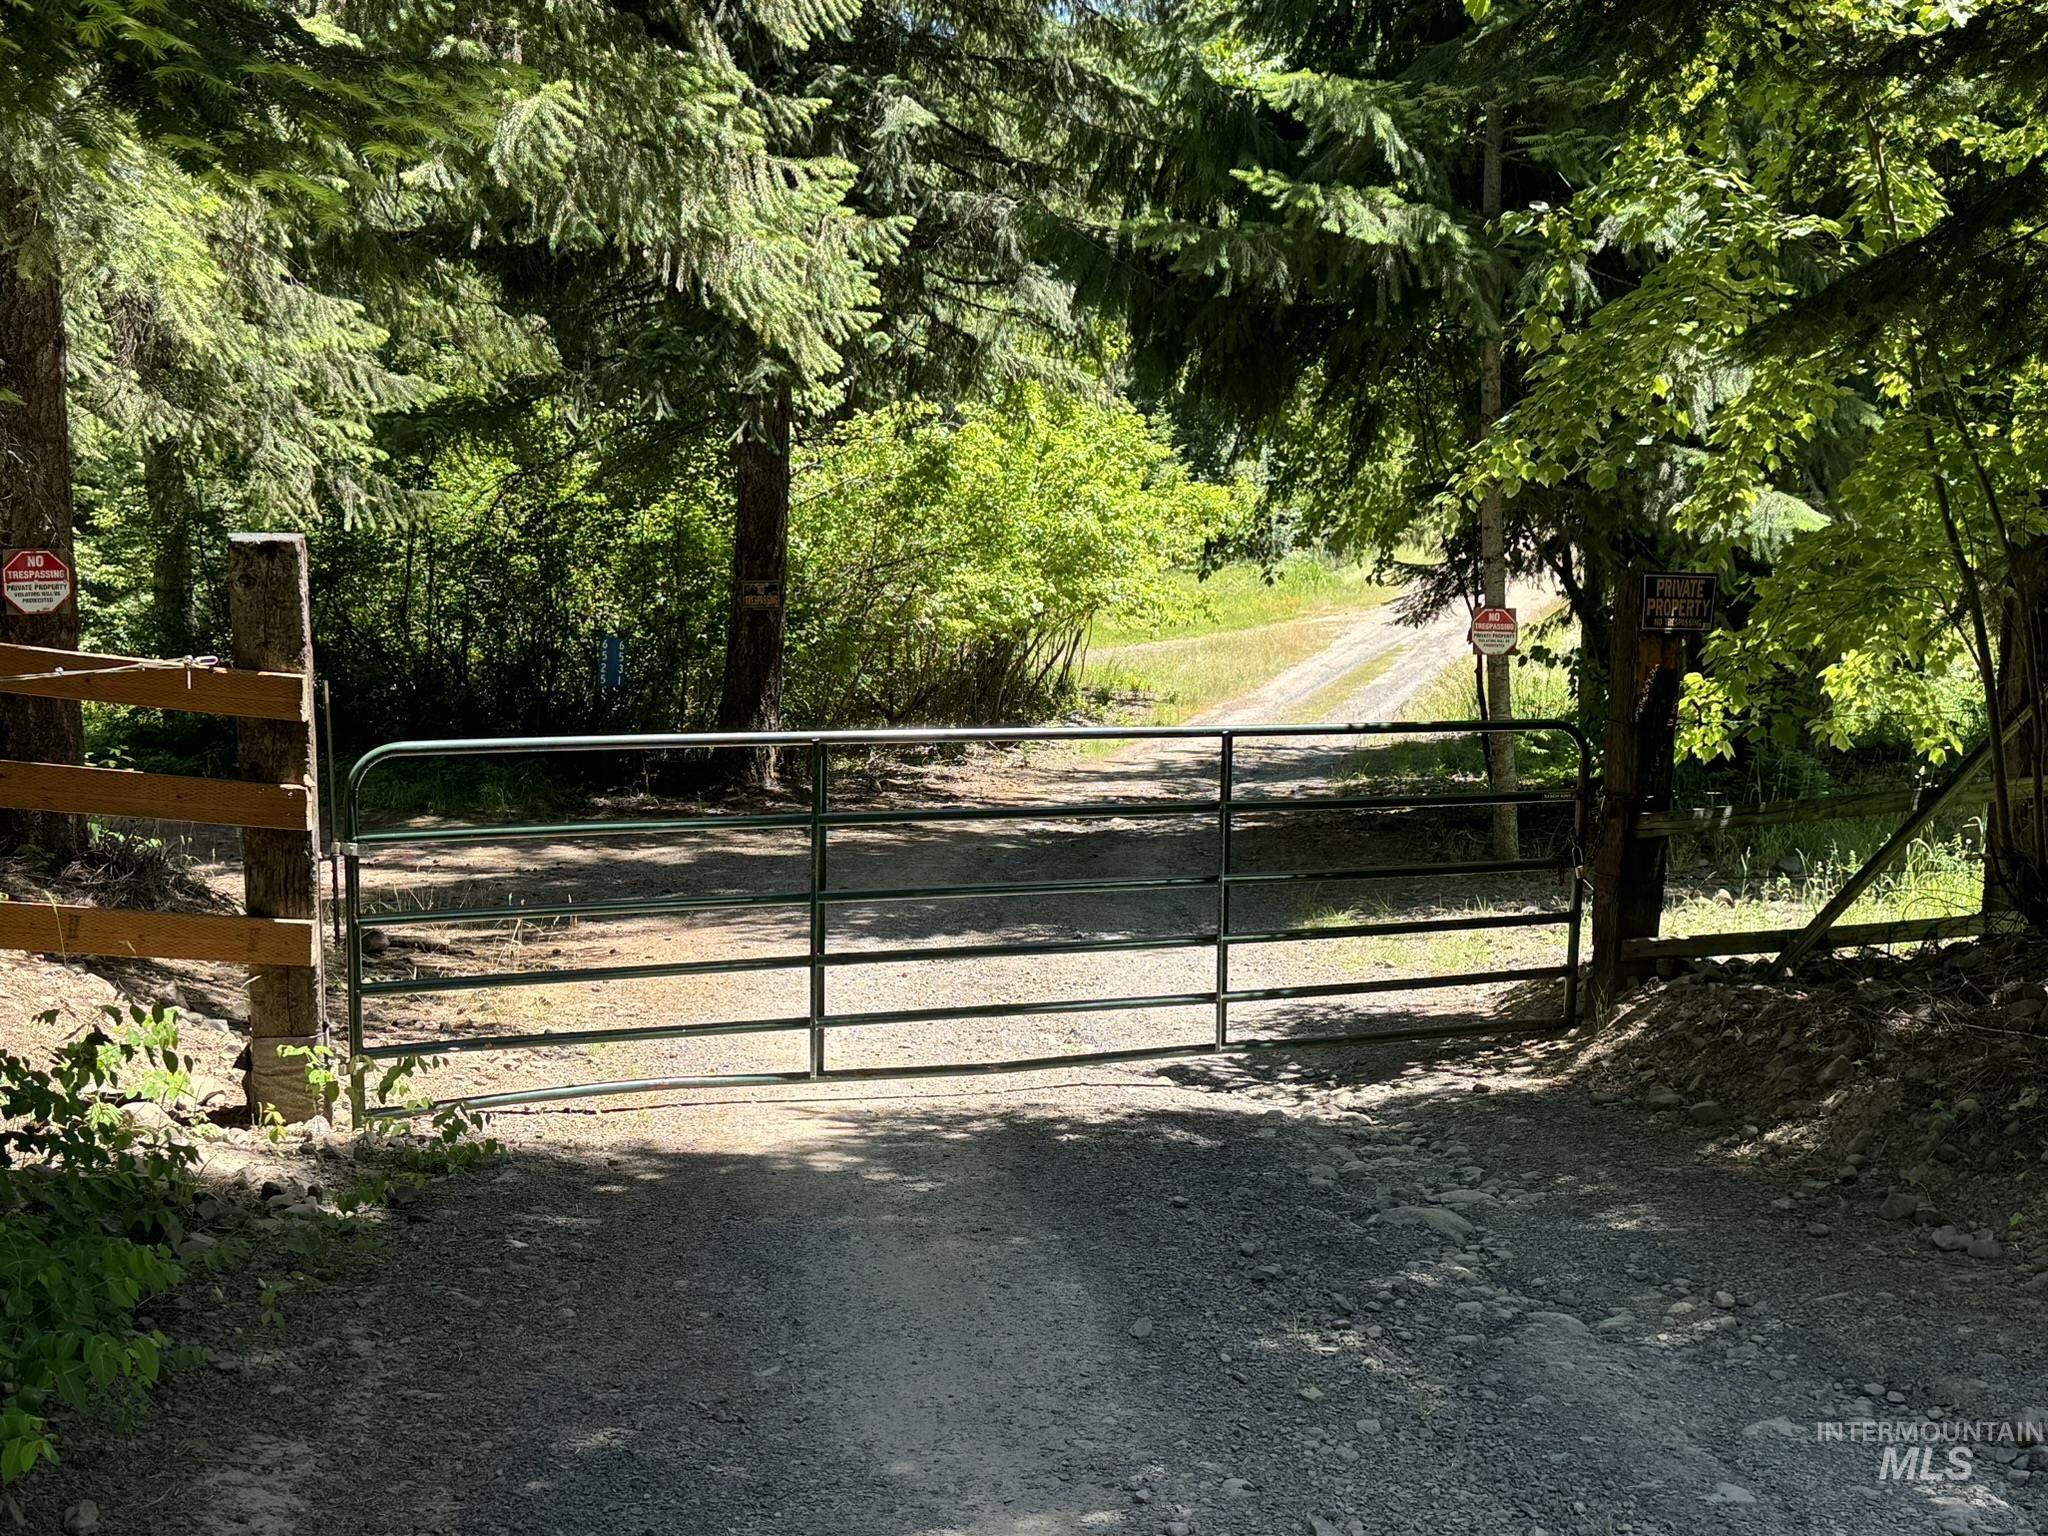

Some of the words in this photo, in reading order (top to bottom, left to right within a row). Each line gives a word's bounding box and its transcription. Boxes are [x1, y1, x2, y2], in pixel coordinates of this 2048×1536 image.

[27, 555, 44, 567] NO
[7, 570, 65, 579] TRESPASSING
[34, 583, 67, 591] PROPERTY
[1656, 578, 1706, 598] PRIVATE
[1646, 598, 1711, 617] PROPERTY
[1488, 612, 1500, 621] NO
[600, 639, 608, 684] 6525
[617, 640, 625, 686] 6531
